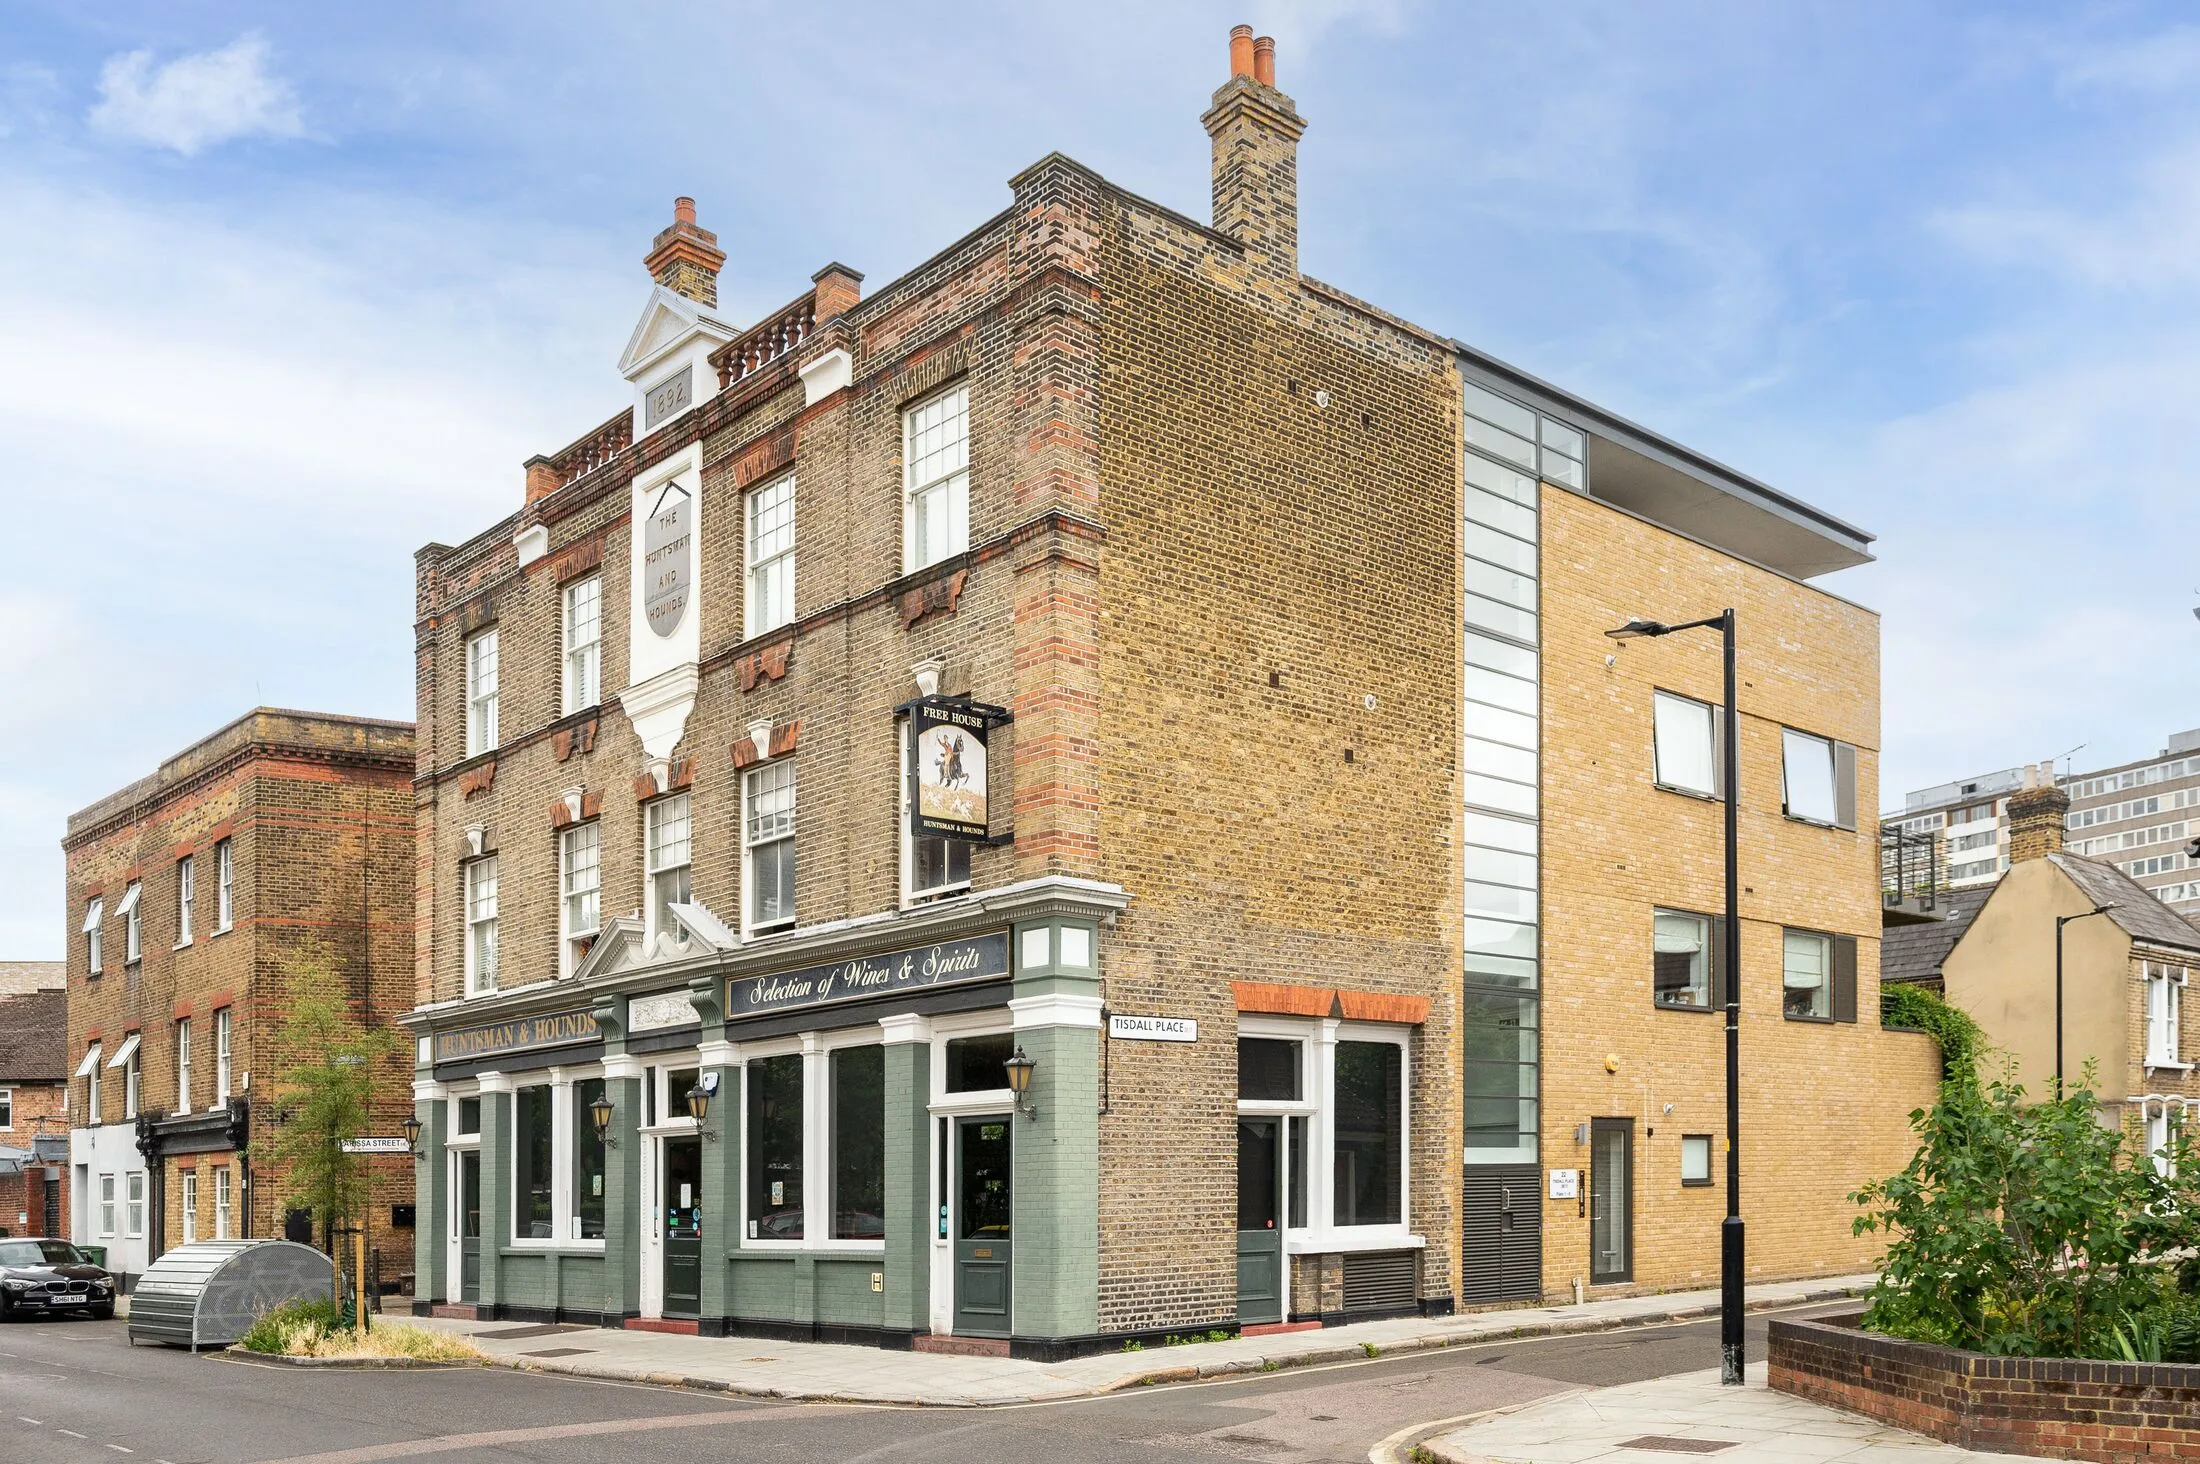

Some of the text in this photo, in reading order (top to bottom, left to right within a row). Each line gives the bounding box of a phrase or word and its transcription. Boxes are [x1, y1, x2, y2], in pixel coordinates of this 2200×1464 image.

[660, 511, 677, 530] THE
[645, 533, 691, 566] HUNTSMAN
[659, 570, 677, 588] AND
[923, 706, 983, 728] FREE HOUSE
[923, 820, 955, 831] HUNTSMAN
[962, 826, 985, 836] HOUNDS
[750, 946, 980, 1004] Selection of Wines & Spirits
[441, 1011, 597, 1056] HUNTSMAN & HOUNDS
[1114, 1018, 1153, 1031] TISDALL
[1156, 1021, 1184, 1033] PLACE
[341, 1139, 371, 1147] ARISSA
[372, 1139, 401, 1147] STREET
